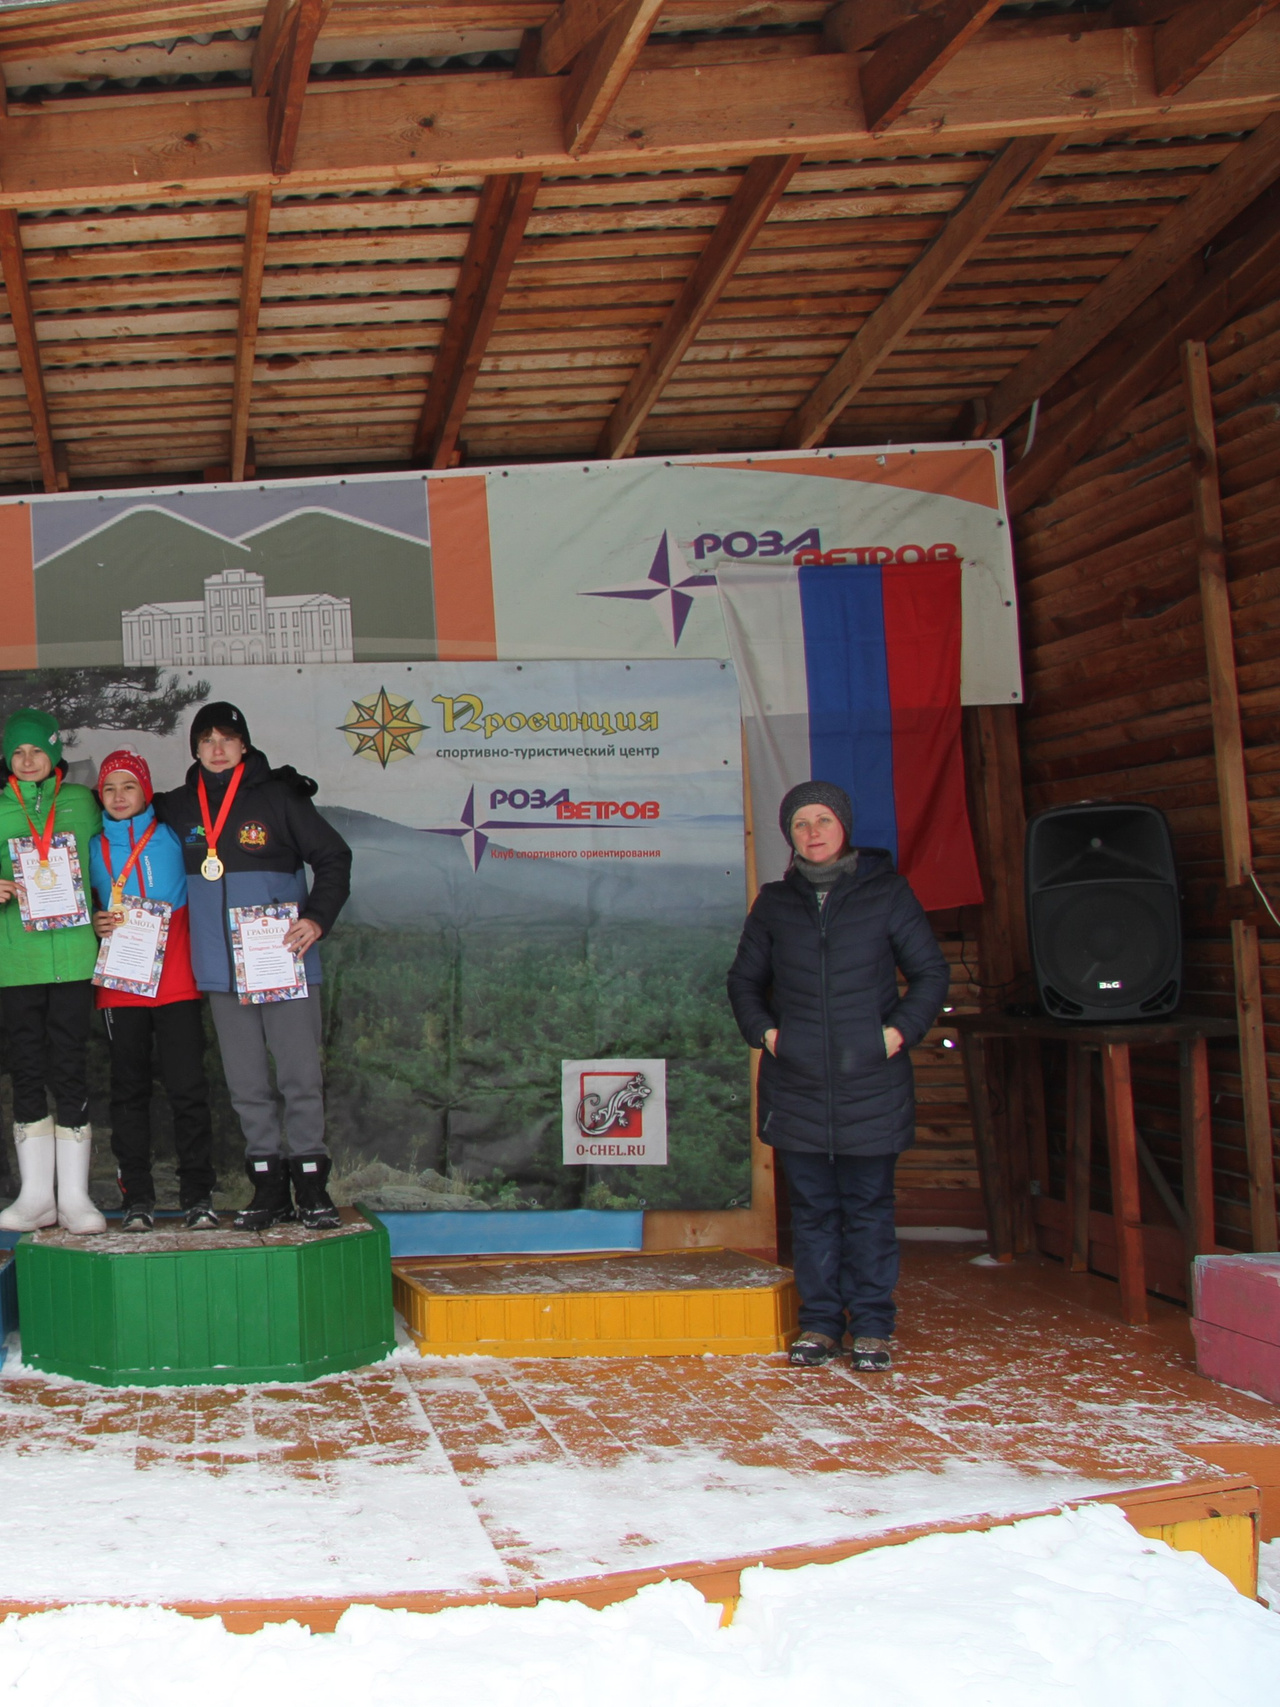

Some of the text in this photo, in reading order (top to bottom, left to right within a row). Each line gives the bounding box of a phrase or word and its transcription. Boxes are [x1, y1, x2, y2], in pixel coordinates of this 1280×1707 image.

[693, 528, 820, 559] РОЗА
[431, 693, 659, 739] Провинция
[436, 743, 660, 761] спортивно-туристический центр
[490, 788, 570, 810] РОЗА
[557, 801, 660, 820] ВЕТРОВ
[26, 855, 64, 866] ГРАОТА
[490, 848, 661, 861] Клуб спортивного ориентирования
[246, 927, 285, 936] ГРАМОТА
[576, 1144, 646, 1156] O-CHEL.RU
